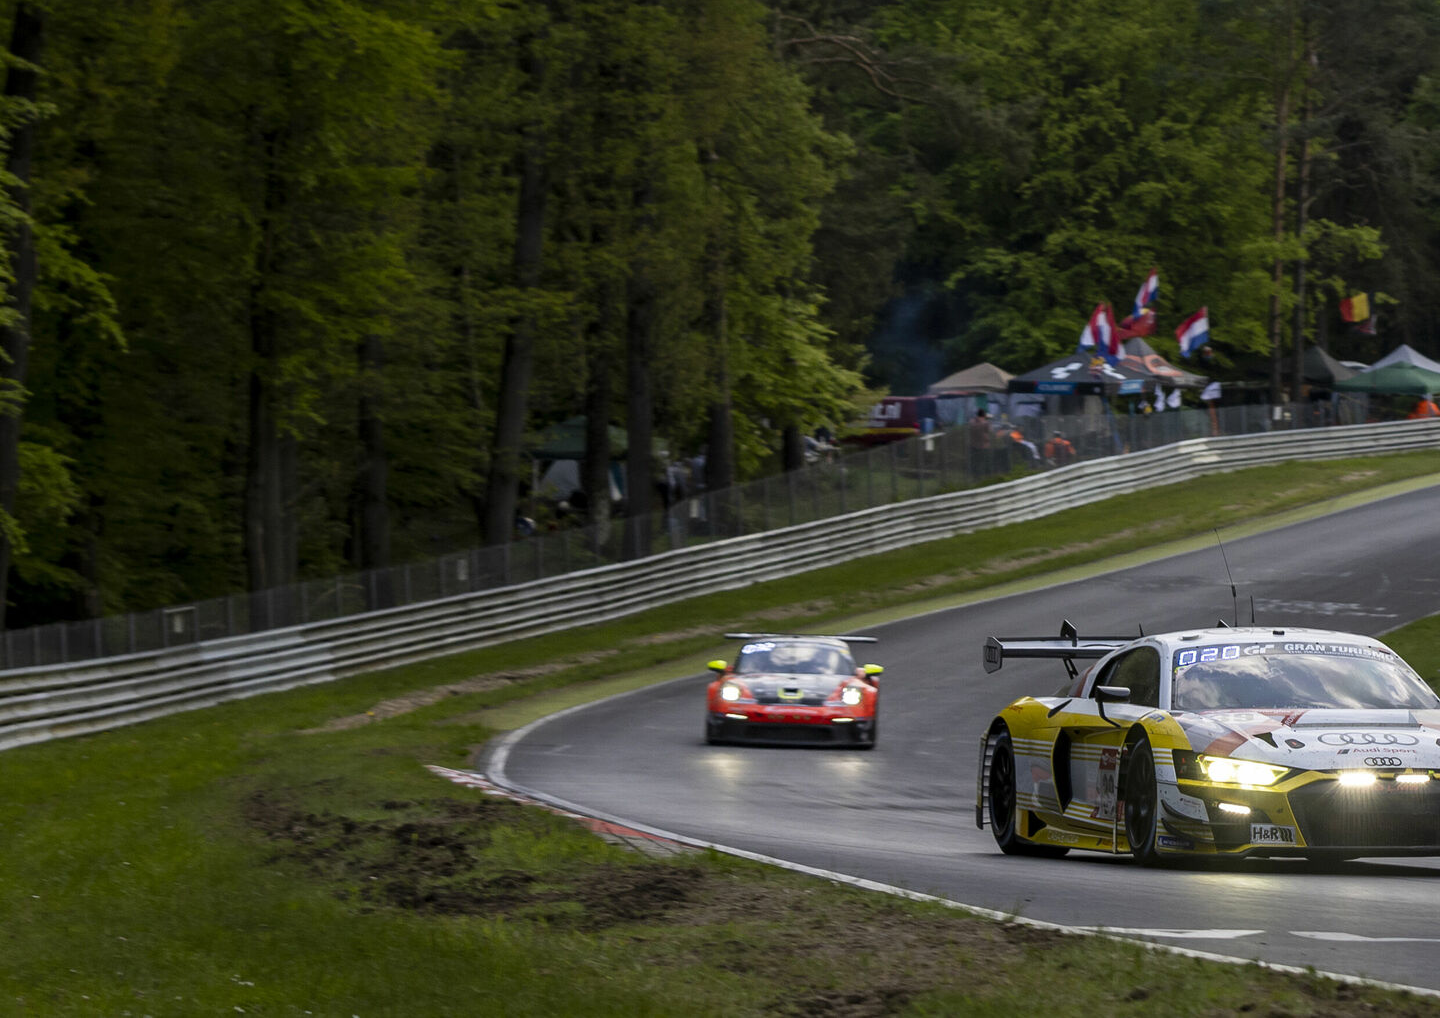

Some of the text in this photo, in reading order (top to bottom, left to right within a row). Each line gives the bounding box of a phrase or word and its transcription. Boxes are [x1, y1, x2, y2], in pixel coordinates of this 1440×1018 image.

[1178, 645, 1241, 666] 020
[1284, 643, 1326, 652] GRAN
[1330, 646, 1395, 661] TURISMO
[1353, 746, 1418, 756] Audi Sport
[1252, 826, 1279, 840] H&R
